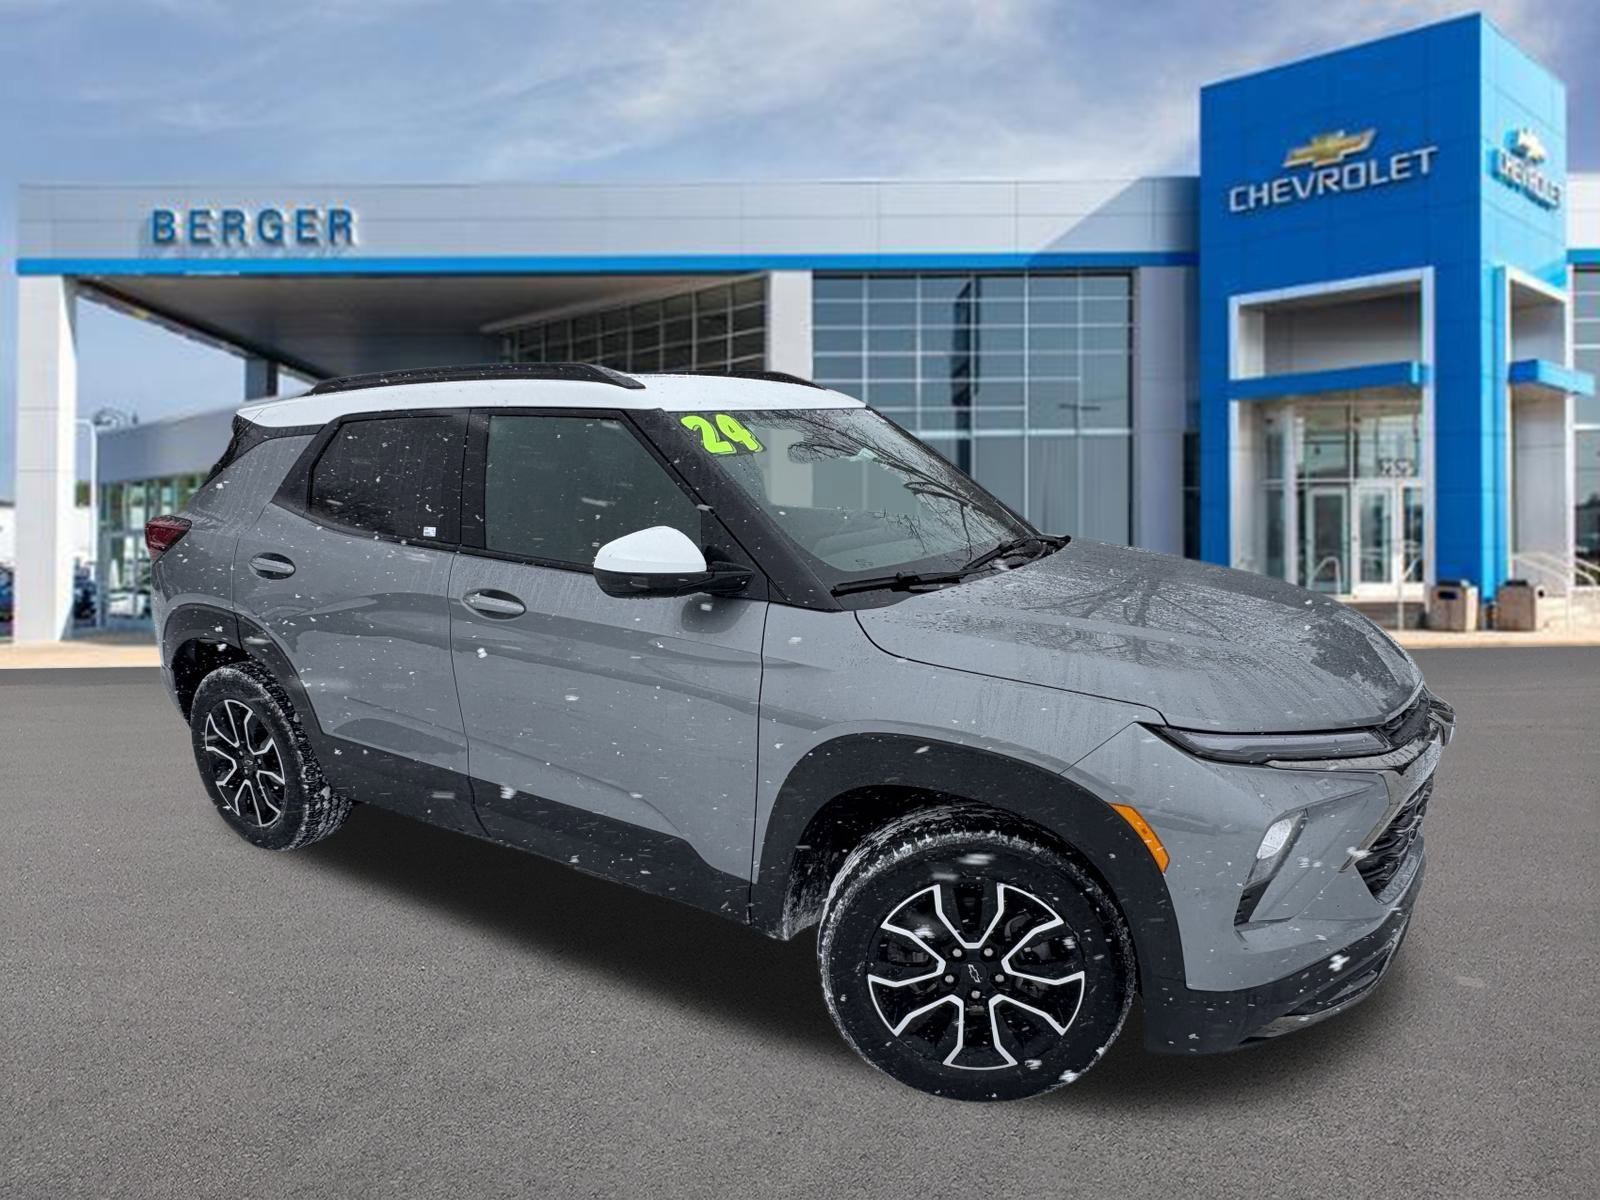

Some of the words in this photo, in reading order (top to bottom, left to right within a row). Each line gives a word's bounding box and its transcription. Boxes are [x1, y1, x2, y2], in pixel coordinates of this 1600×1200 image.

[1229, 145, 1438, 213] CHEVROLET
[152, 208, 355, 246] BERGER
[681, 414, 763, 454] 24
